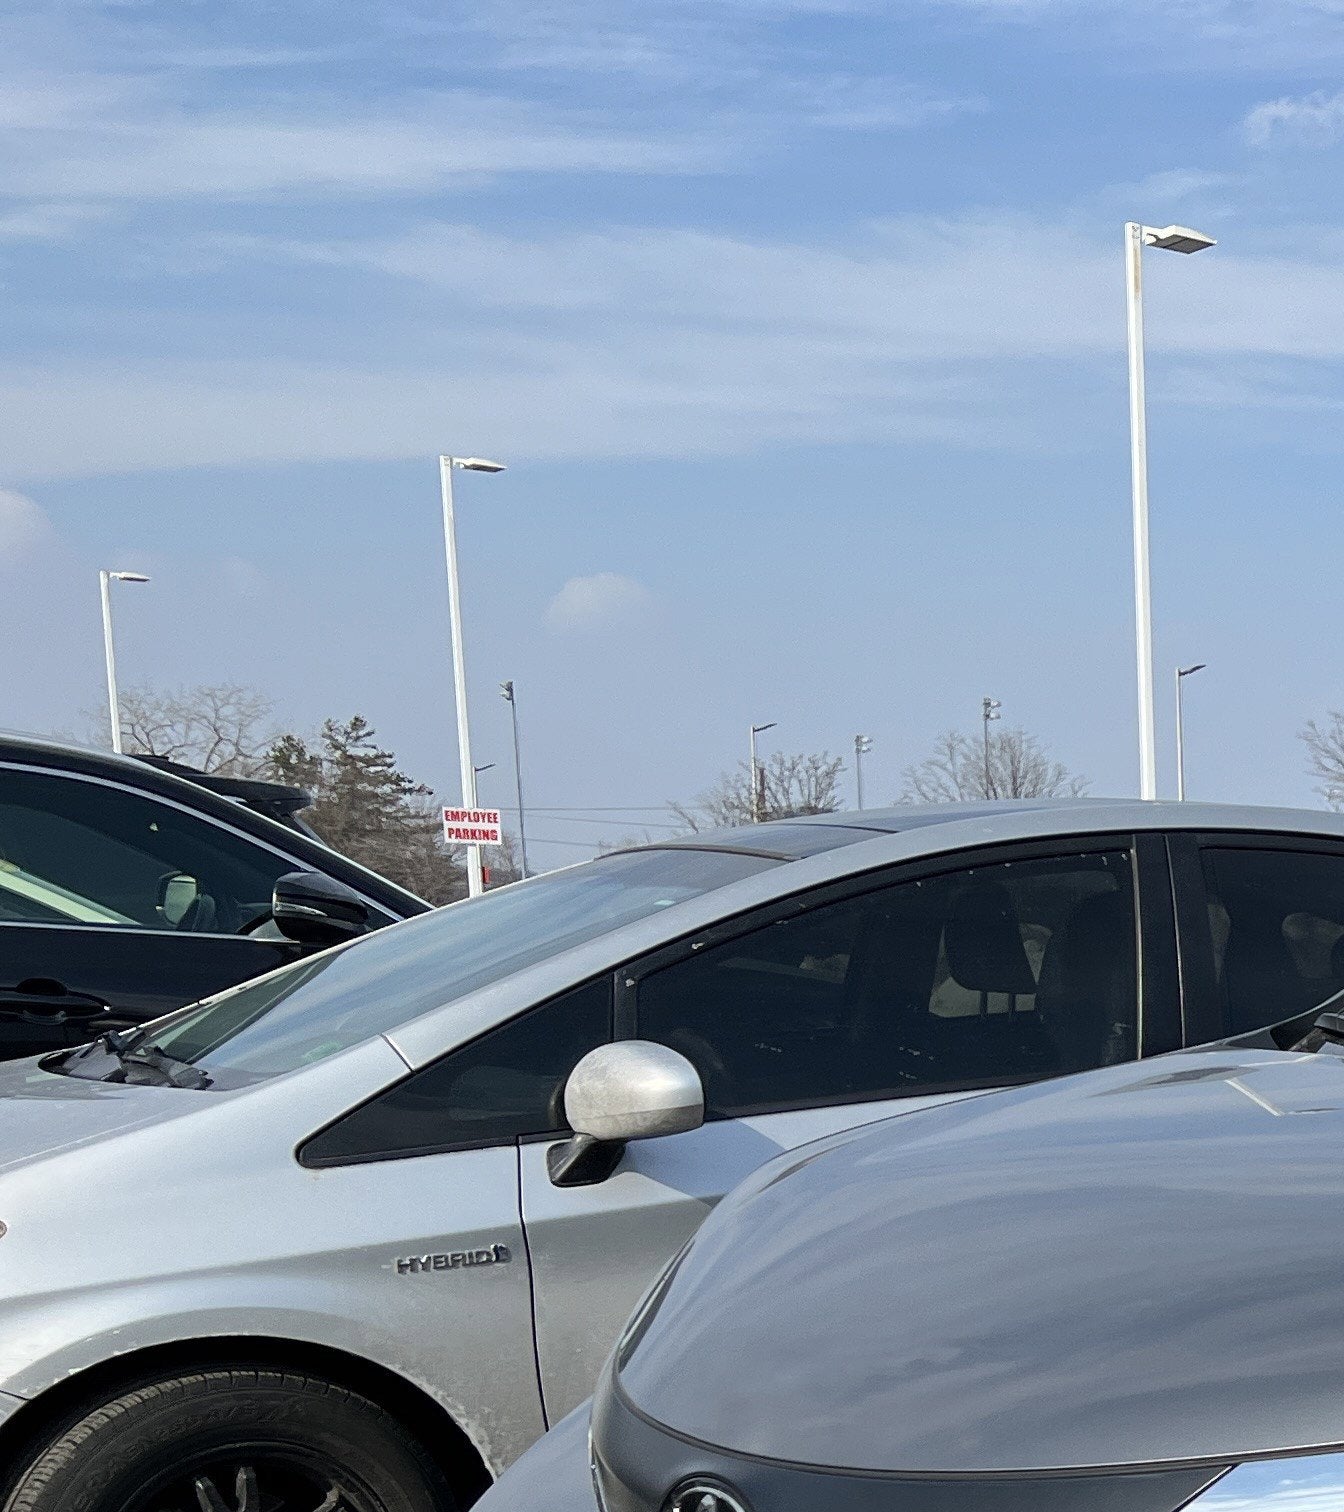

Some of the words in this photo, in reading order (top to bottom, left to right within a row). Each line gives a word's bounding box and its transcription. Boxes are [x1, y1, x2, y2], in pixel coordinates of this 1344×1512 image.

[444, 809, 499, 825] EMPLOYEE
[447, 827, 498, 842] PARKING
[396, 1248, 493, 1276] HYBRID
